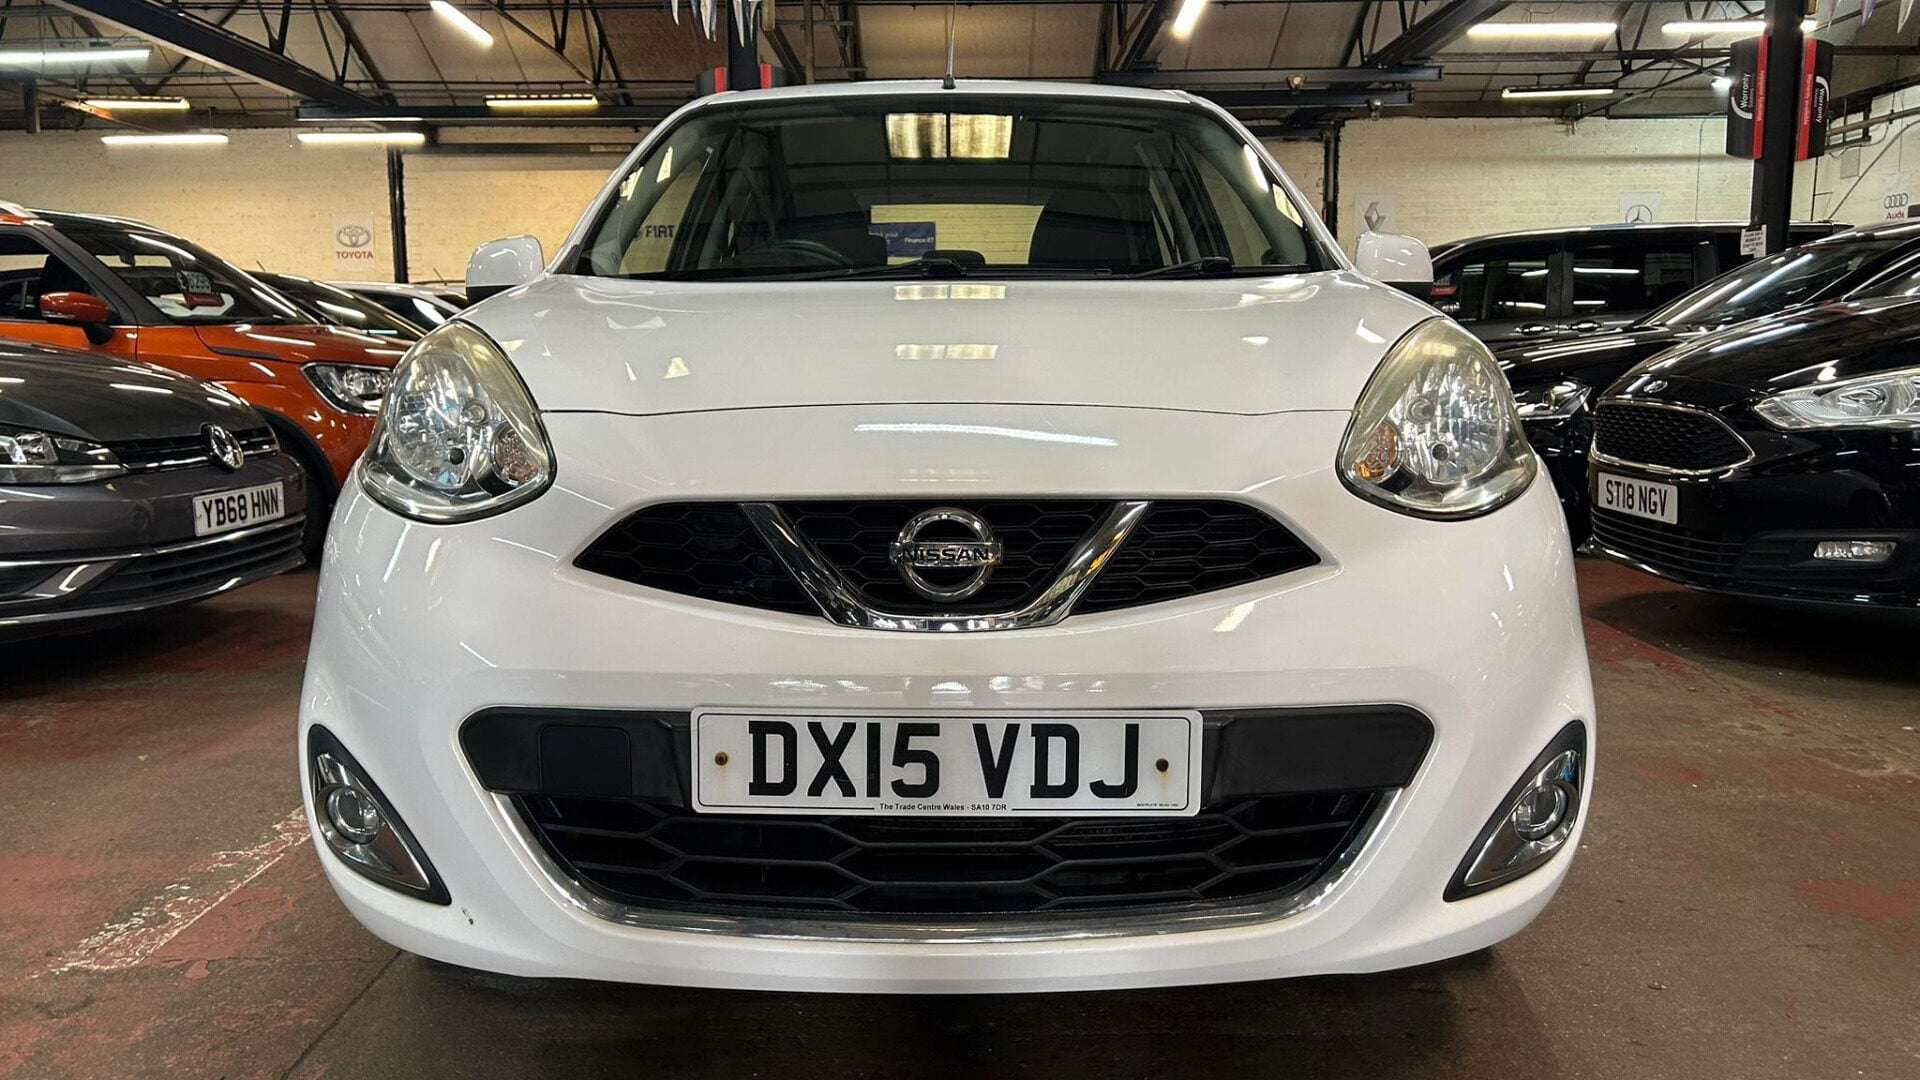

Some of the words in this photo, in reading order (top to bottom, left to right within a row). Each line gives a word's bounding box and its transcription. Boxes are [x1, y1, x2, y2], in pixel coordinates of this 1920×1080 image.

[1740, 73, 1752, 109] Warranty
[1815, 88, 1825, 123] Warranty
[1887, 210, 1905, 219] Audi
[645, 225, 674, 238] FIAT
[336, 251, 373, 259] TOYOTA
[202, 494, 247, 528] YB68
[251, 487, 279, 518] HNN
[1606, 479, 1635, 510] ST18
[1639, 485, 1667, 517] NGV
[899, 547, 991, 561] NISSAN
[748, 720, 940, 798] DX15
[972, 723, 1139, 798] VDJ
[880, 803, 893, 811] The
[895, 803, 915, 811] Trade
[943, 803, 965, 811] Wales
[971, 803, 989, 811] SA10
